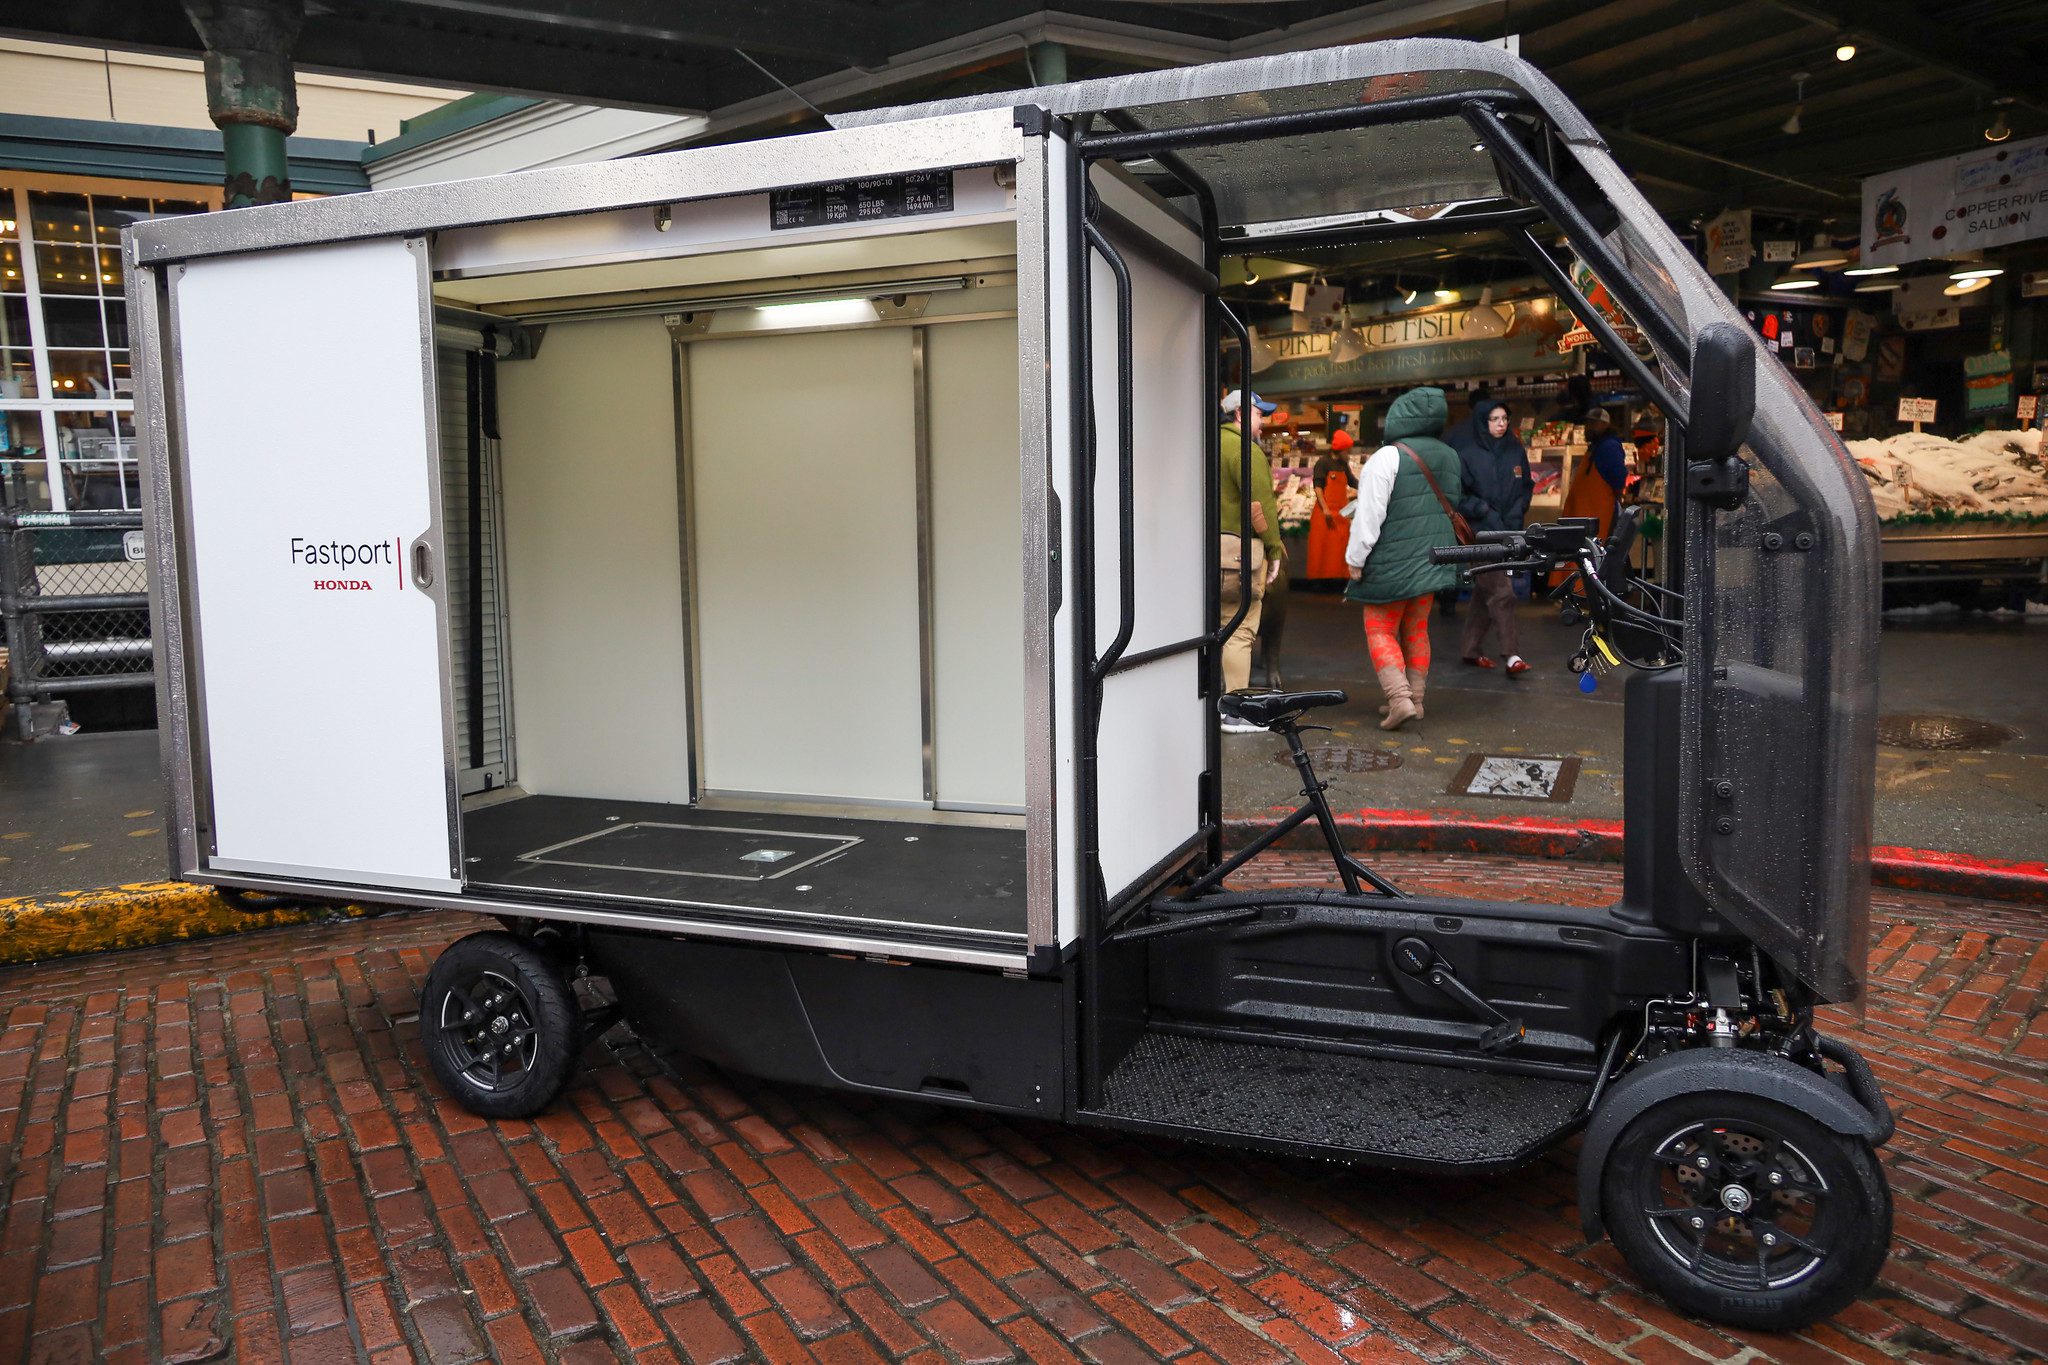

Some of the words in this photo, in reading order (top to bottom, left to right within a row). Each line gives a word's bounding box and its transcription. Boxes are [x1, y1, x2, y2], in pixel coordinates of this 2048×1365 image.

[925, 173, 931, 181] V
[834, 184, 845, 192] PSI
[858, 179, 893, 189] 100/90-10
[858, 201, 871, 209] 650
[872, 199, 885, 207] LBS
[906, 196, 921, 204] 29.4
[921, 194, 931, 202] Ah
[833, 204, 848, 213] Mph
[906, 203, 922, 211] 1494
[922, 201, 934, 209] Wh
[1945, 198, 2007, 221] CPPER
[2011, 189, 2048, 208] RIVE
[834, 211, 847, 220] Kph
[1968, 212, 2031, 234] SALMN
[1279, 334, 1327, 356] PIKE
[1329, 322, 1398, 351] PCE
[1403, 312, 1454, 341] FISH
[291, 537, 392, 571] Fastport
[313, 580, 372, 590] HONDA
